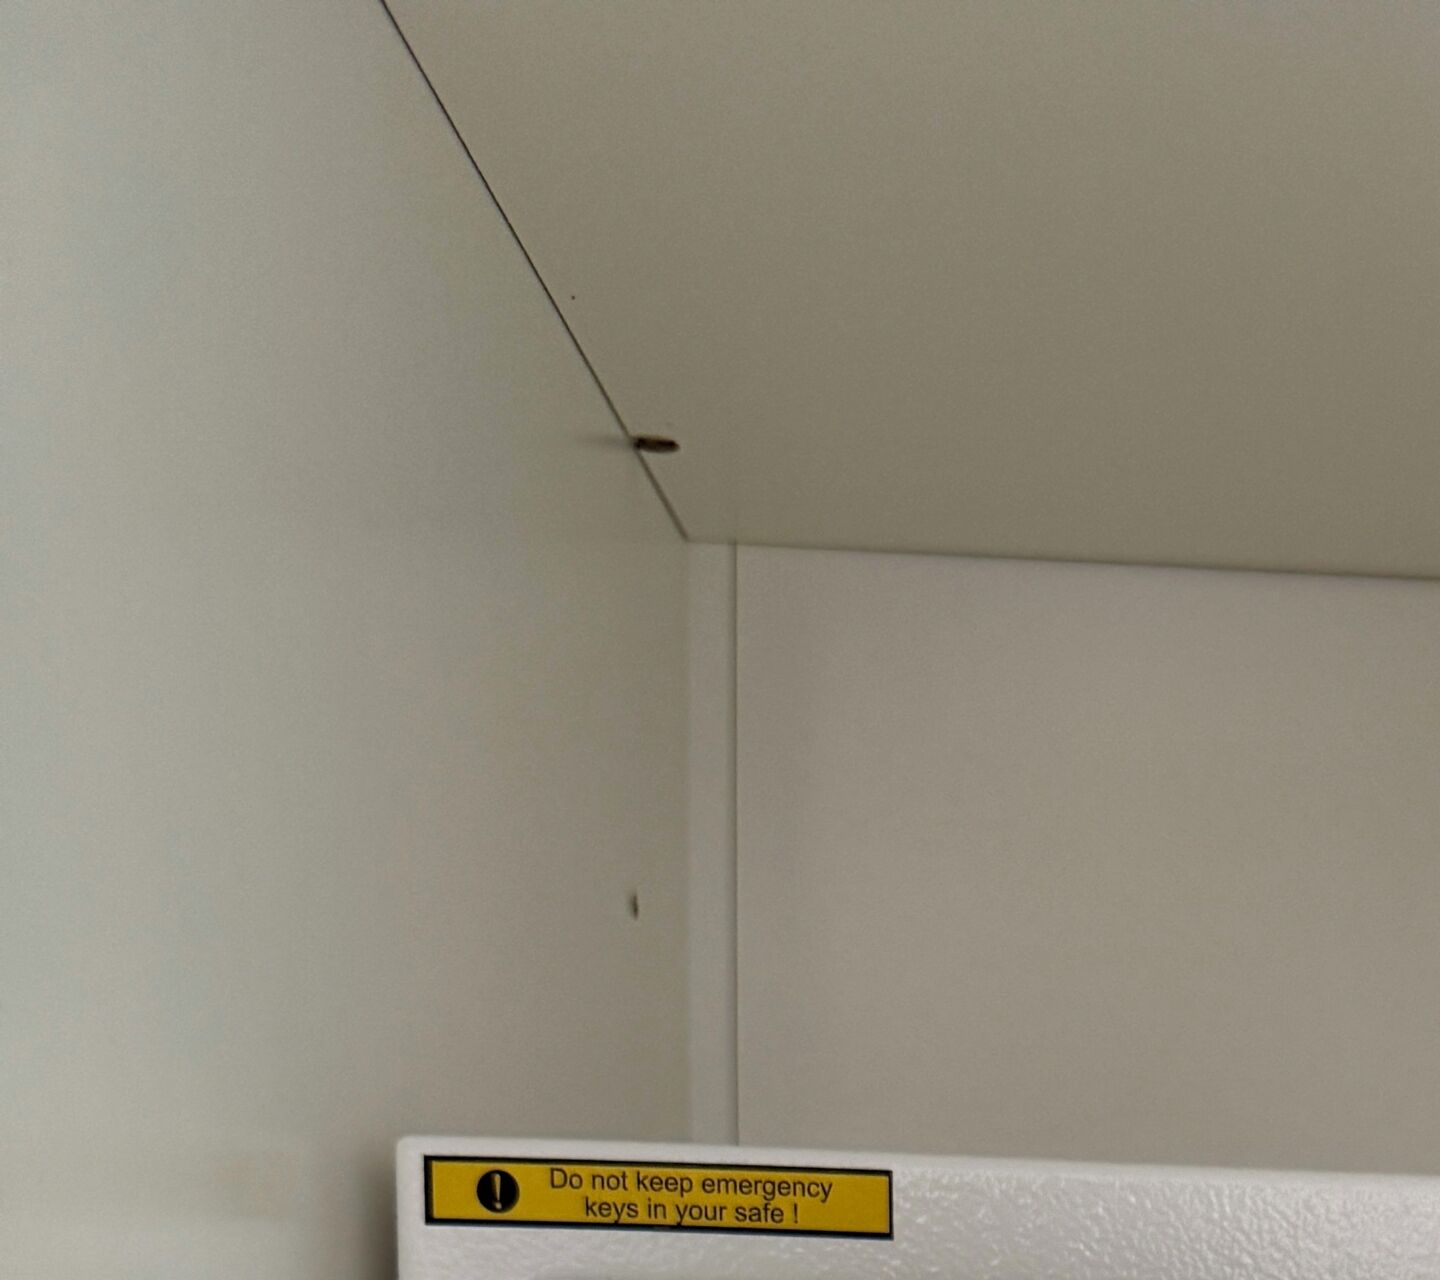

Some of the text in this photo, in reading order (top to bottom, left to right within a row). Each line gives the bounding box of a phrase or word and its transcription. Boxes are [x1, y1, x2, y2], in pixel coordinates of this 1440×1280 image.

[550, 1168, 833, 1204] Do not keep emergency
[584, 1197, 640, 1225] keys
[647, 1198, 667, 1219] in
[675, 1204, 728, 1227] your
[735, 1200, 784, 1223] safe
